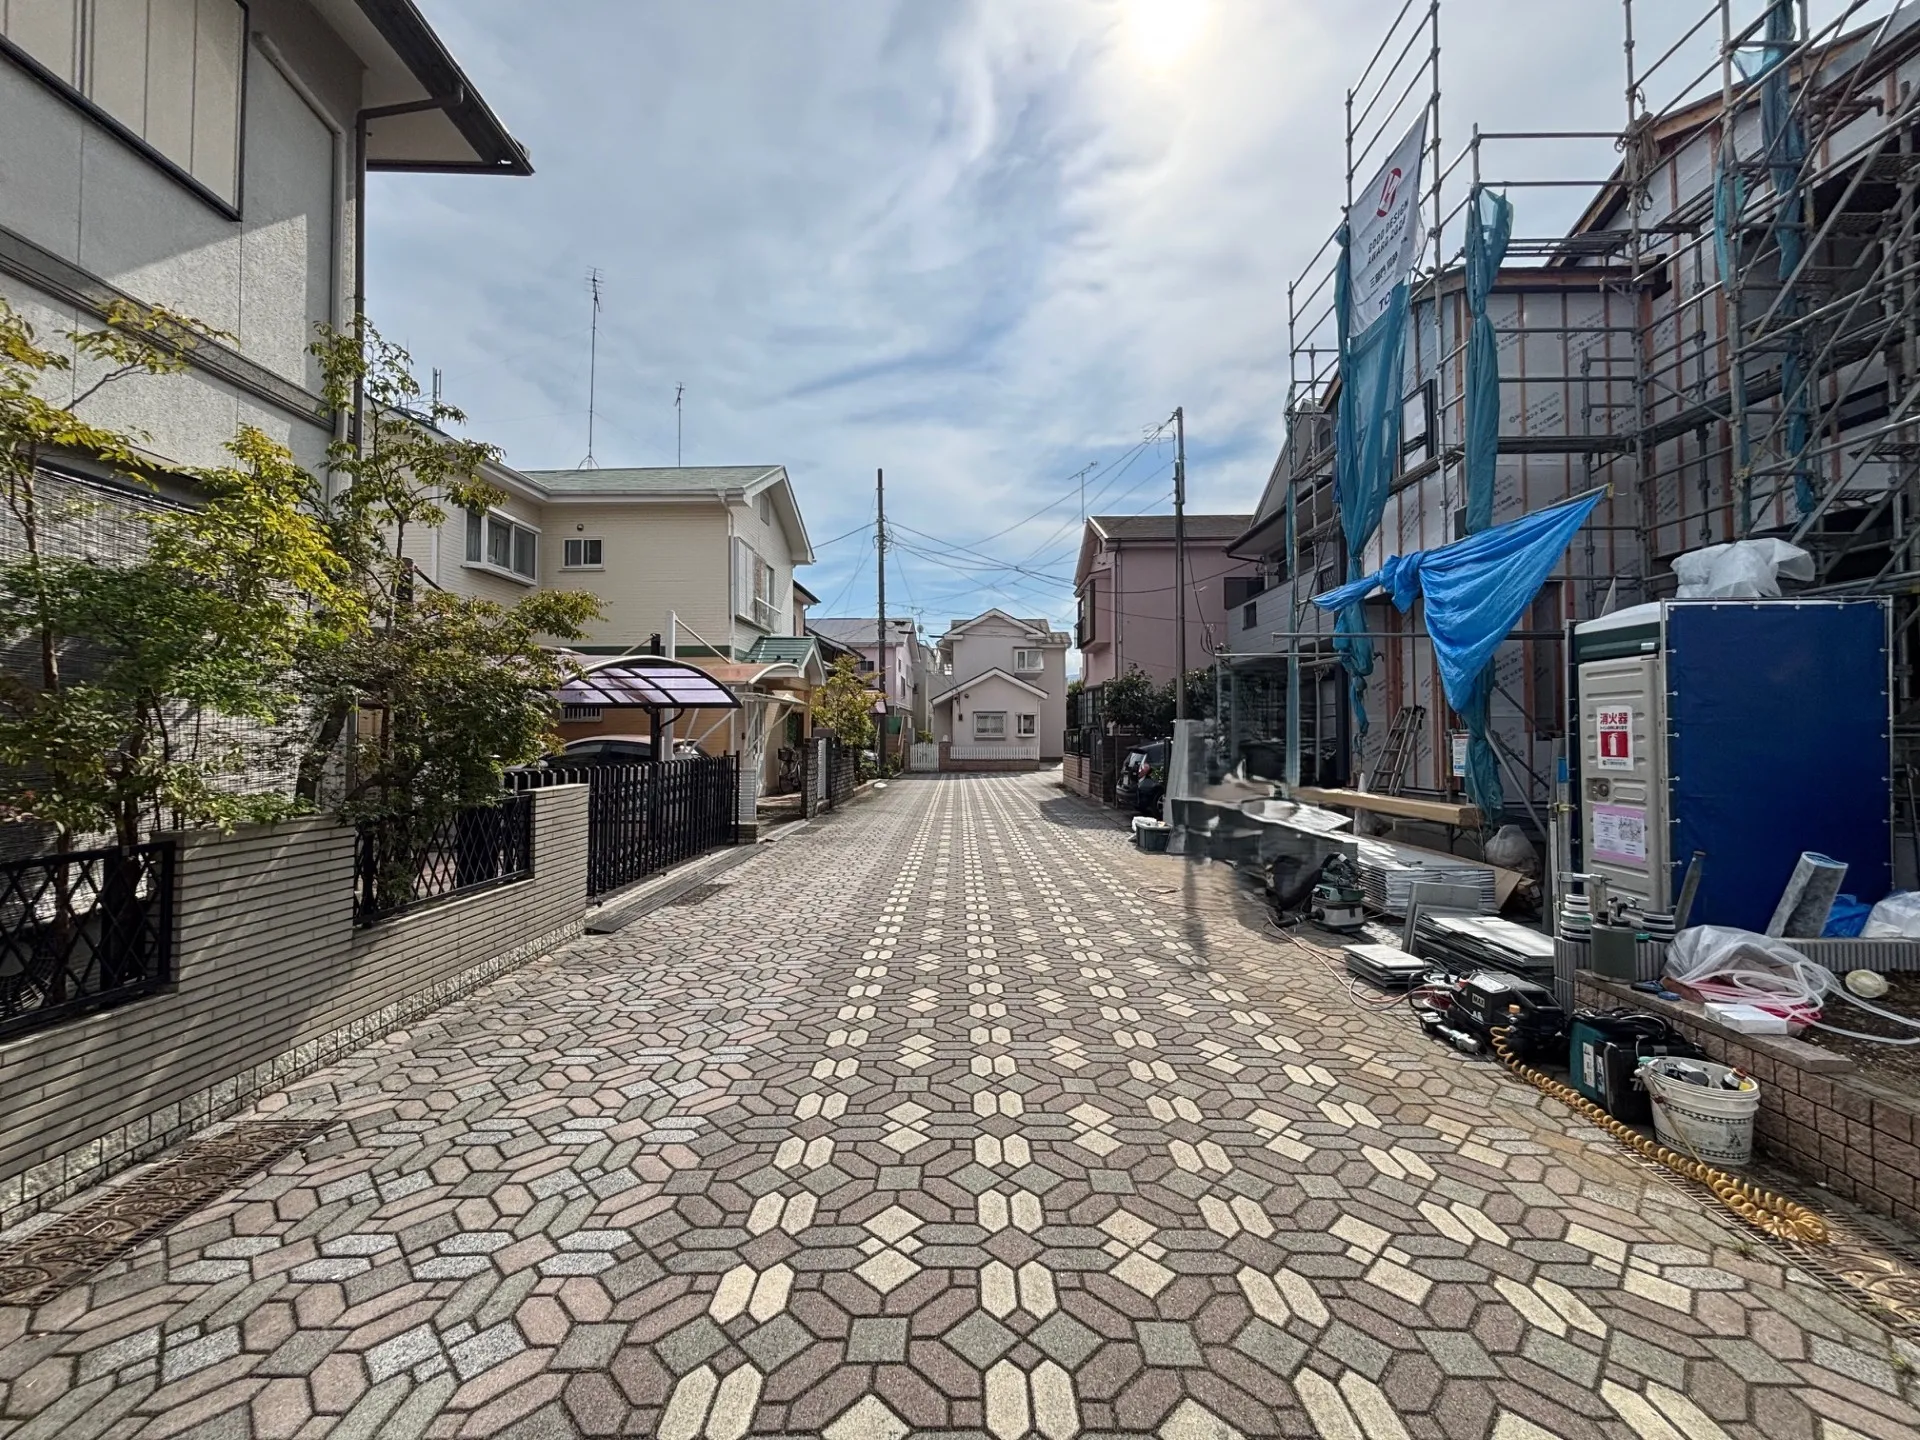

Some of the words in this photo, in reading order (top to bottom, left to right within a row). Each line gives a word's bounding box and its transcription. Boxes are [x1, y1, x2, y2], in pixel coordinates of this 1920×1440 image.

[1368, 227, 1385, 254] GOOD
[1385, 197, 1409, 233] DESIGN
[1367, 236, 1389, 267] AWARD
[1600, 712, 1628, 725] 消火器
[1472, 994, 1485, 1007] MAX
